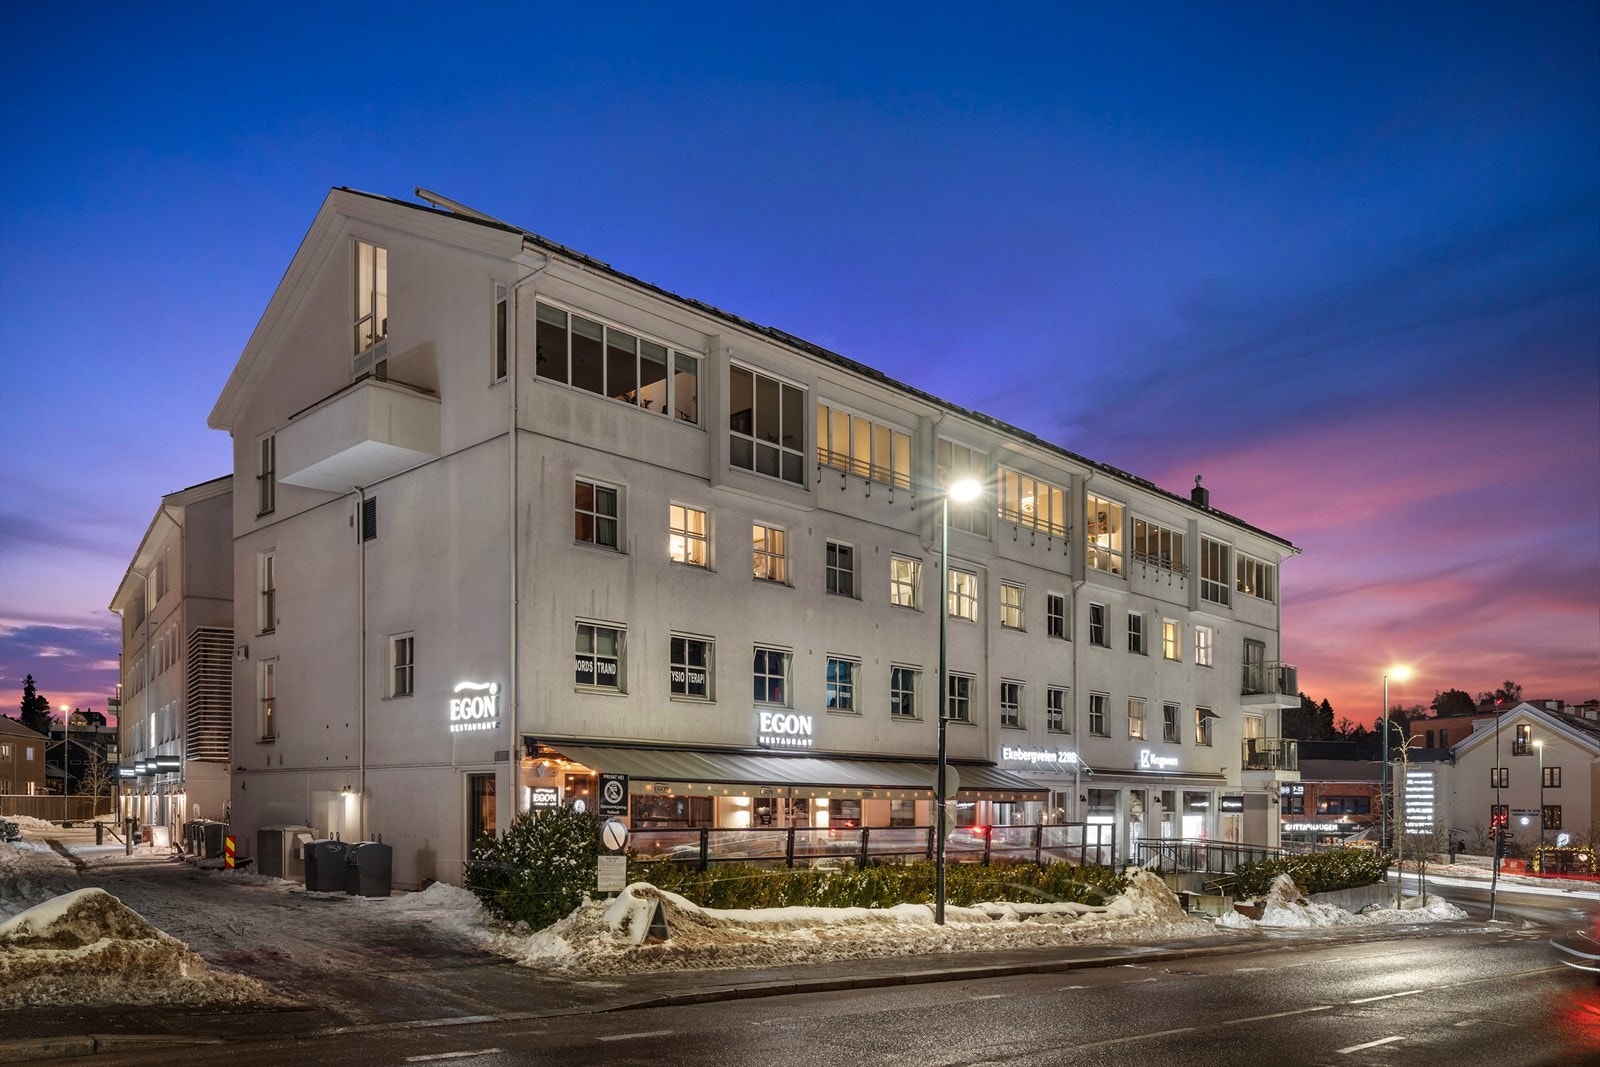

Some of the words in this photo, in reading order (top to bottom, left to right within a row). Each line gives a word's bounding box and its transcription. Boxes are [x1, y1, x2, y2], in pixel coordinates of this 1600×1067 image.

[450, 696, 496, 720] EGON
[450, 722, 496, 732] RESTAURANT
[760, 712, 812, 735] EGON
[760, 737, 812, 746] RESTAURANT
[1003, 747, 1056, 763] Ekebergveien
[533, 794, 557, 802] EGON
